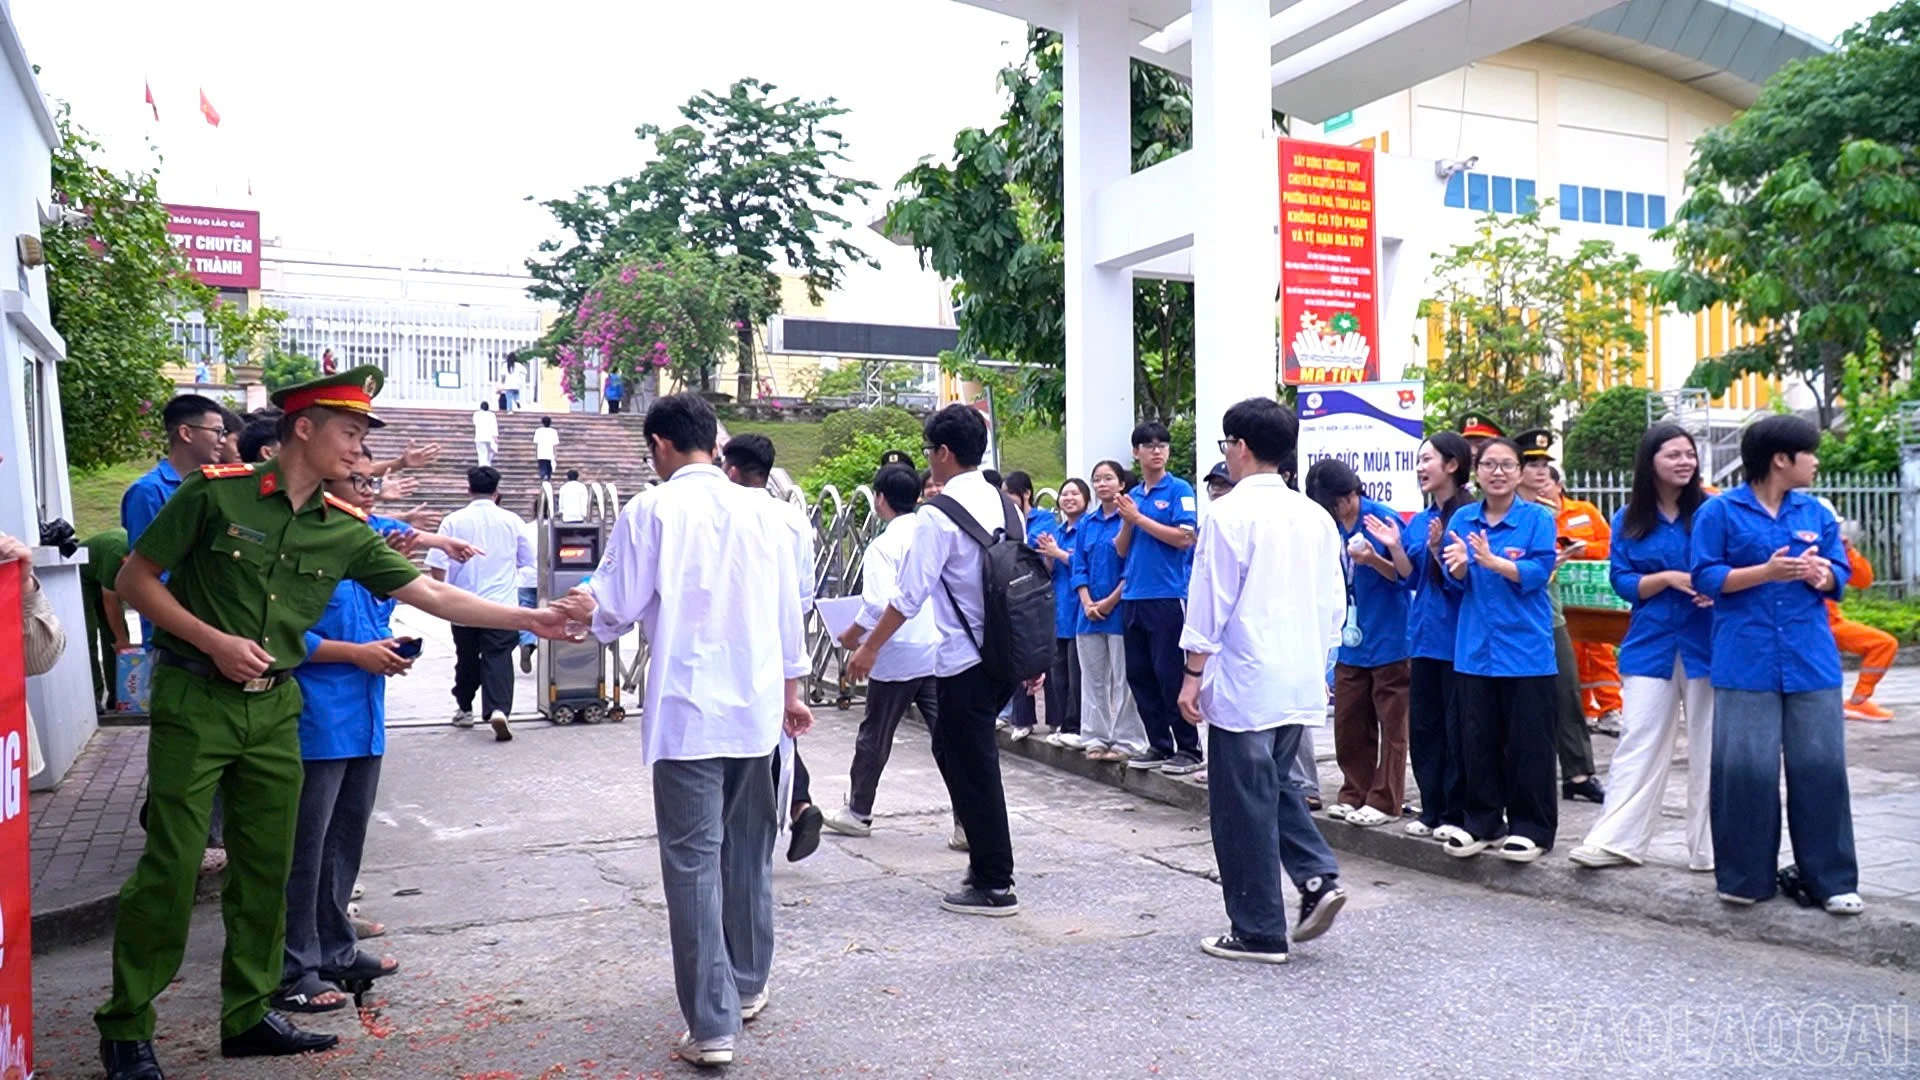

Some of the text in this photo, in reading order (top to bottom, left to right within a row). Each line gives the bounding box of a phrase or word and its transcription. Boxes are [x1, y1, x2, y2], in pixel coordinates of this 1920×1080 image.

[195, 234, 253, 254] CHUYÊN
[194, 255, 243, 275] THÀNH
[1300, 367, 1326, 383] MA
[1363, 447, 1390, 472] MÙA
[1395, 451, 1414, 471] THI
